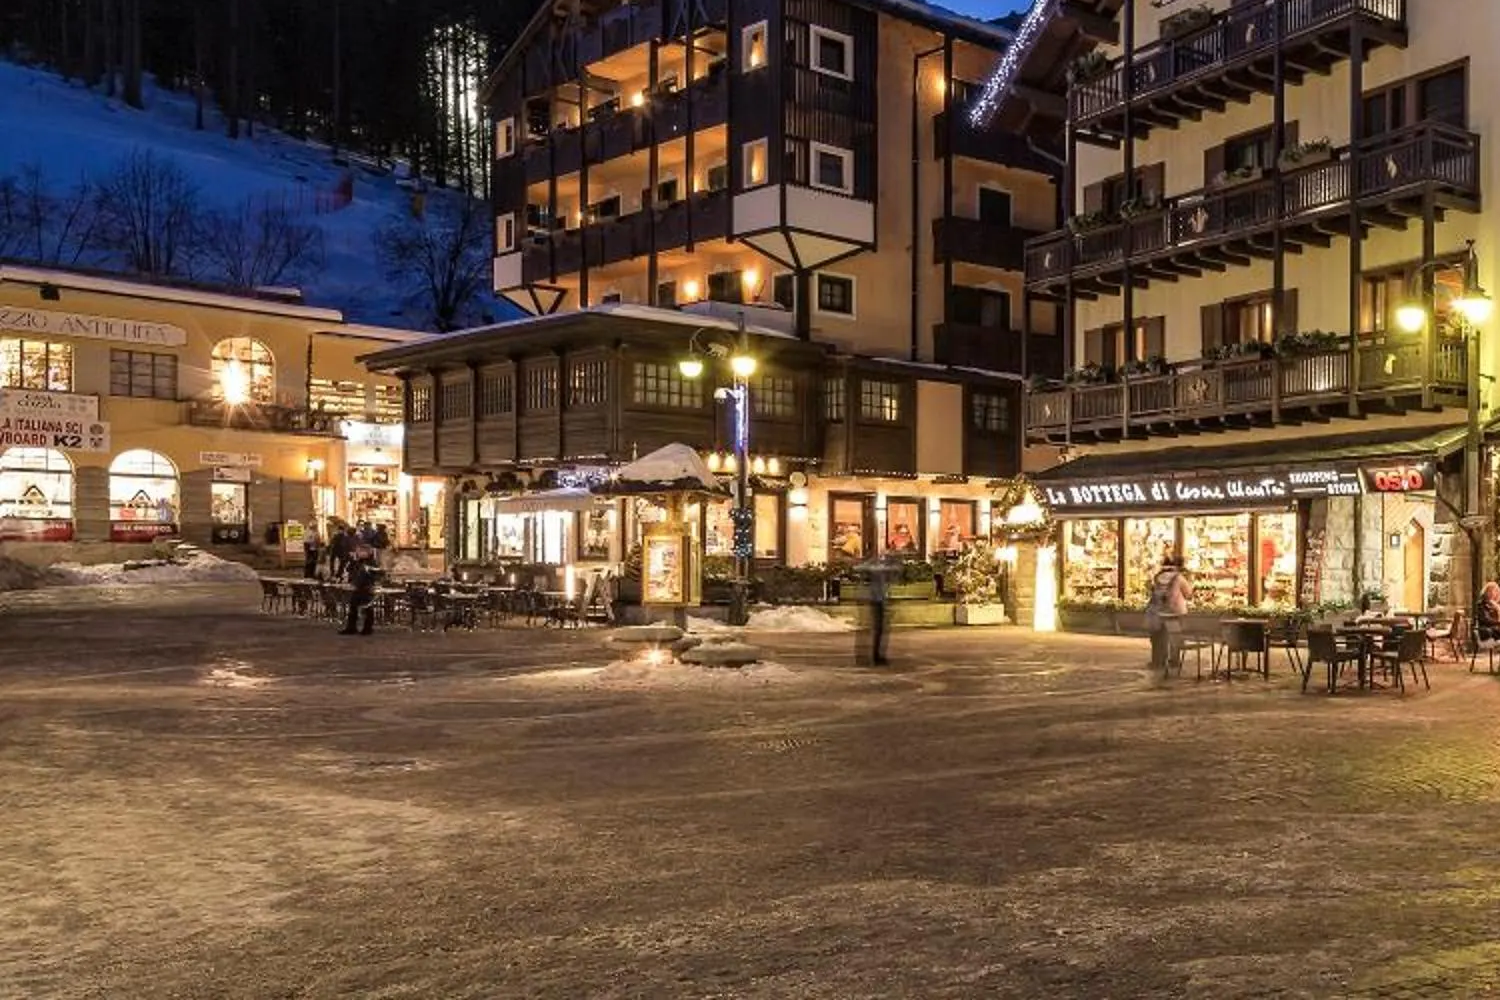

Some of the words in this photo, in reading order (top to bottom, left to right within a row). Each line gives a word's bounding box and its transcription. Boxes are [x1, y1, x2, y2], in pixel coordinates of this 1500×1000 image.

[15, 417, 62, 433] ITALIANA
[65, 421, 82, 434] SCI
[53, 434, 82, 448] K2
[1069, 483, 1147, 503] BOTTEGA
[1151, 481, 1170, 501] di
